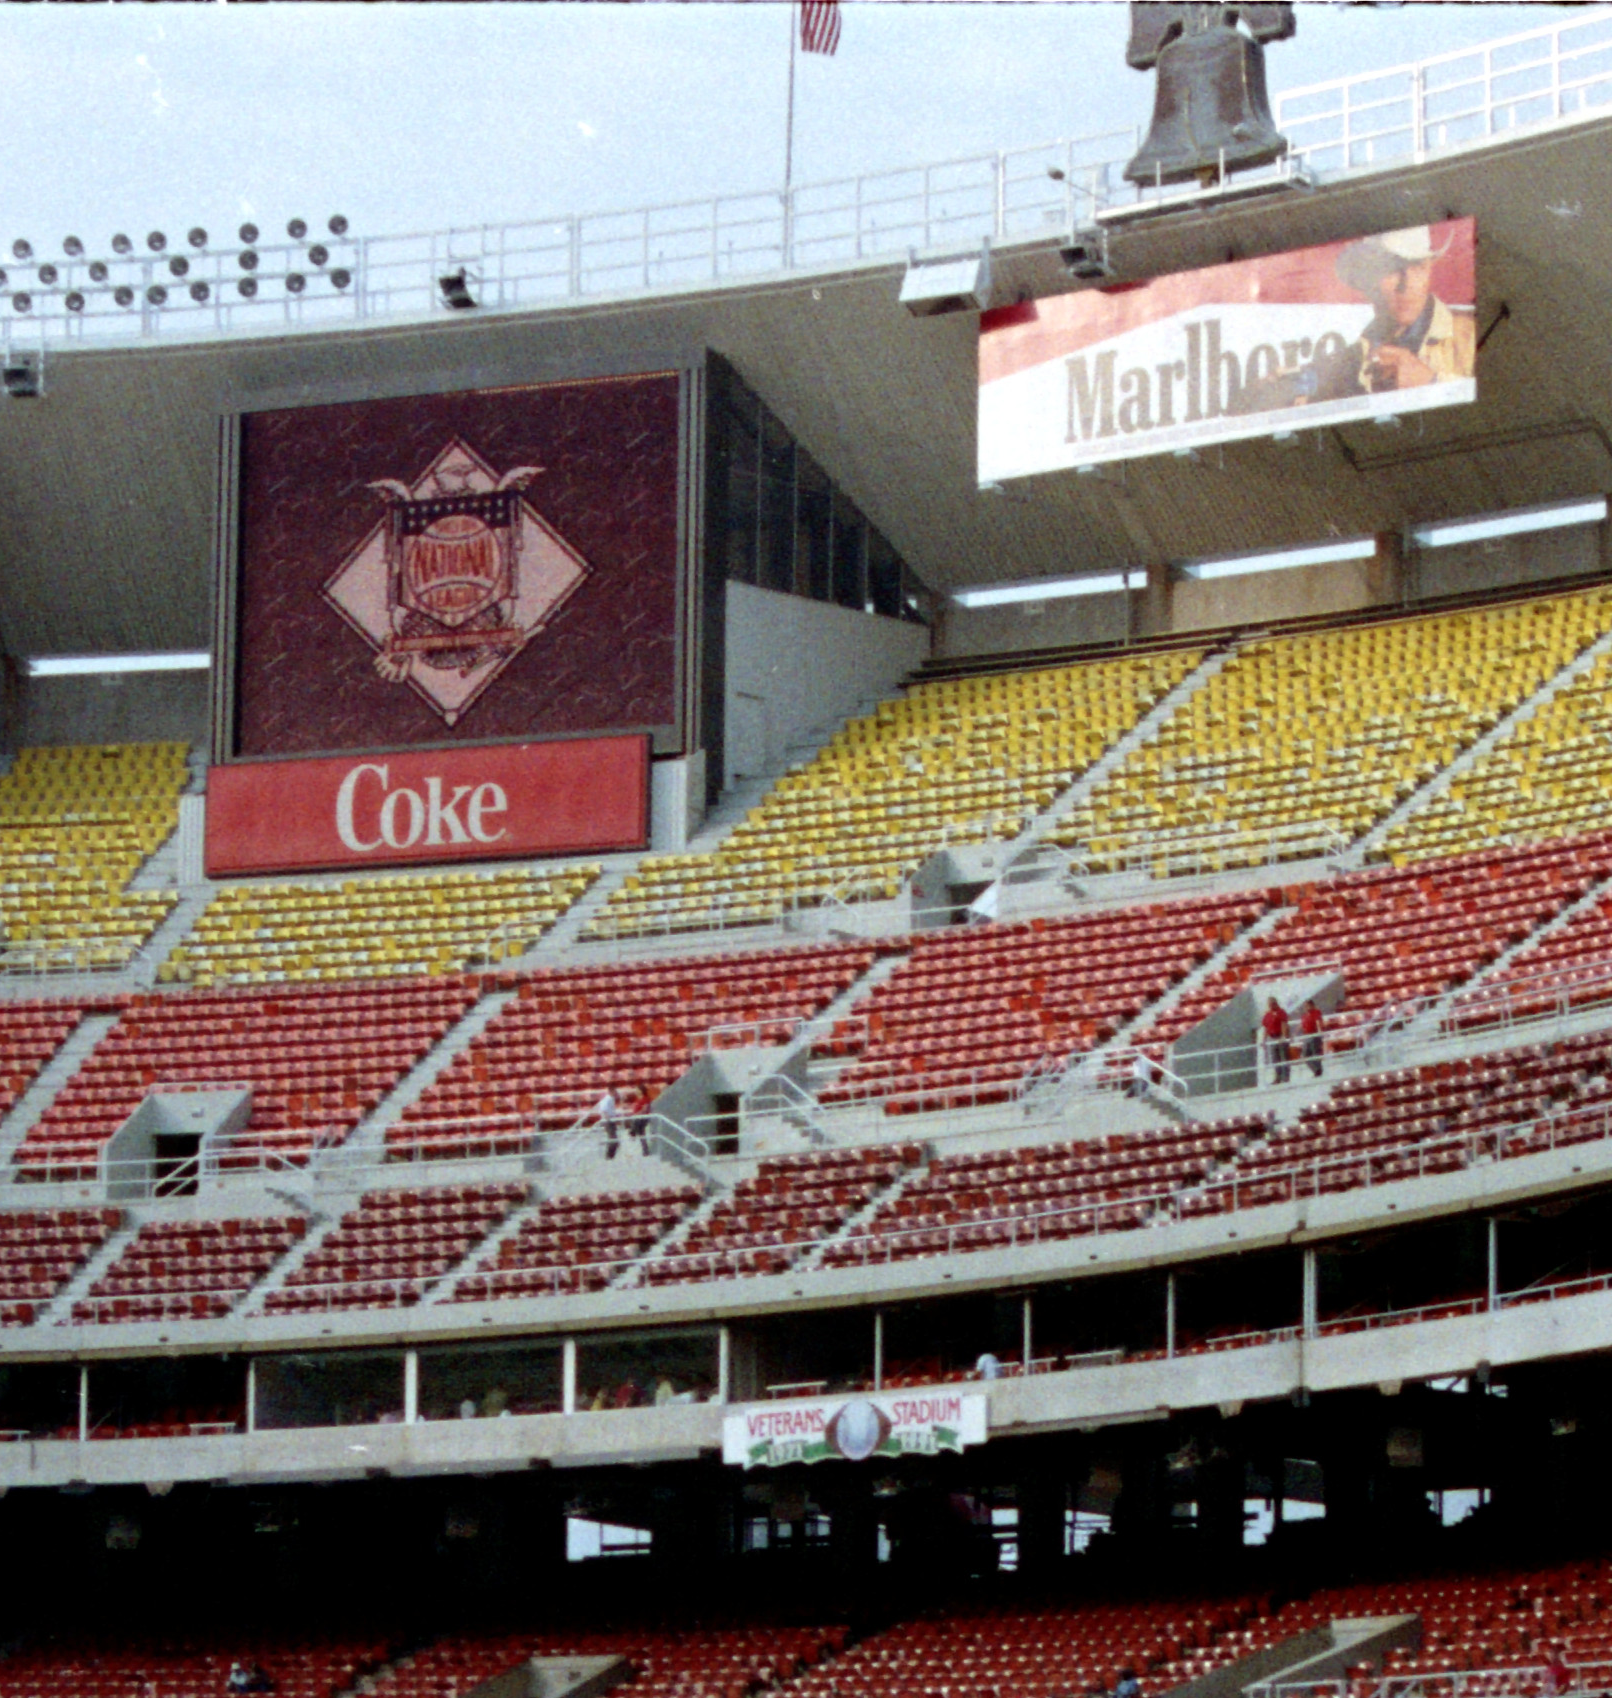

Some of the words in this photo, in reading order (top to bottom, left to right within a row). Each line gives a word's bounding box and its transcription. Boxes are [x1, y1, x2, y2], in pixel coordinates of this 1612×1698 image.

[336, 763, 508, 853] Coke
[747, 1407, 826, 1440] VETERANS
[891, 1397, 962, 1427] STADIUM
